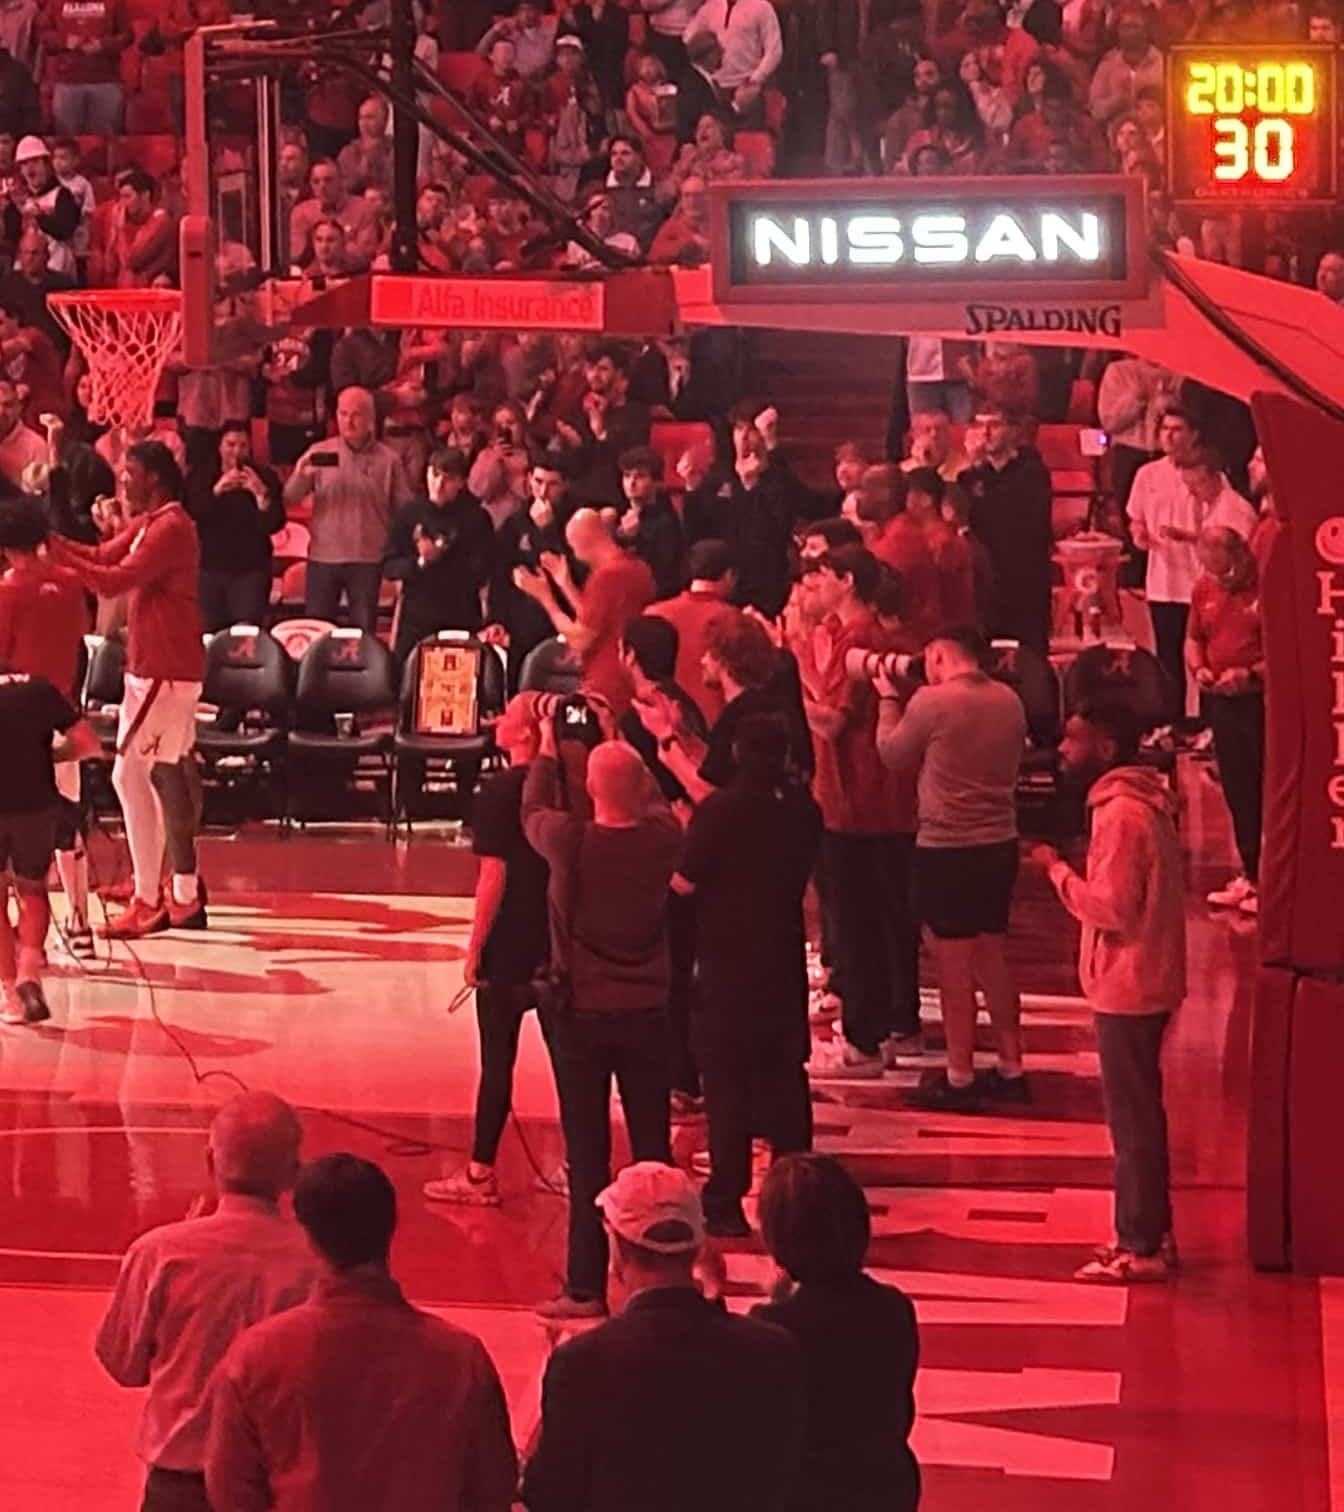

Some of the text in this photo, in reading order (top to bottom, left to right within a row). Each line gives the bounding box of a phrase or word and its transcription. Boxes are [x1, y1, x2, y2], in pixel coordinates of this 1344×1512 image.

[1187, 63, 1315, 114] 20:00
[1214, 118, 1294, 180] 30
[753, 213, 1100, 266] NISSAN
[417, 284, 593, 323] Alfa Insurance
[965, 304, 1121, 339] SPALDING
